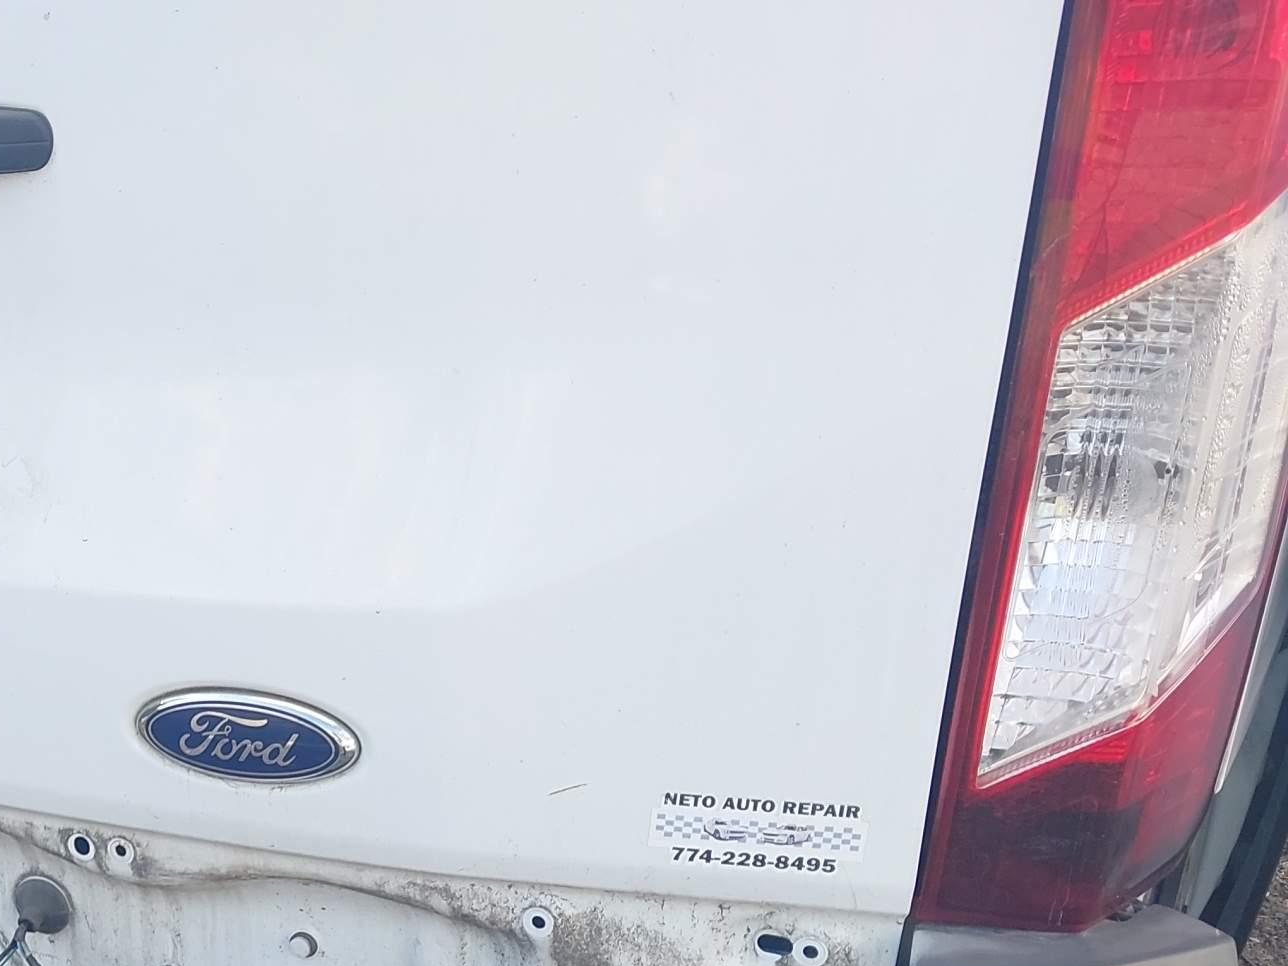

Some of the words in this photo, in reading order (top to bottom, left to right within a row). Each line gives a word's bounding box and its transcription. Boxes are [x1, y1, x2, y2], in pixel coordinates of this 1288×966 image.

[178, 710, 298, 767] Ford
[663, 792, 717, 809] NETO
[722, 797, 776, 813] AUTO
[782, 801, 861, 819] REPAIR
[671, 846, 837, 873] 774-228-8495
